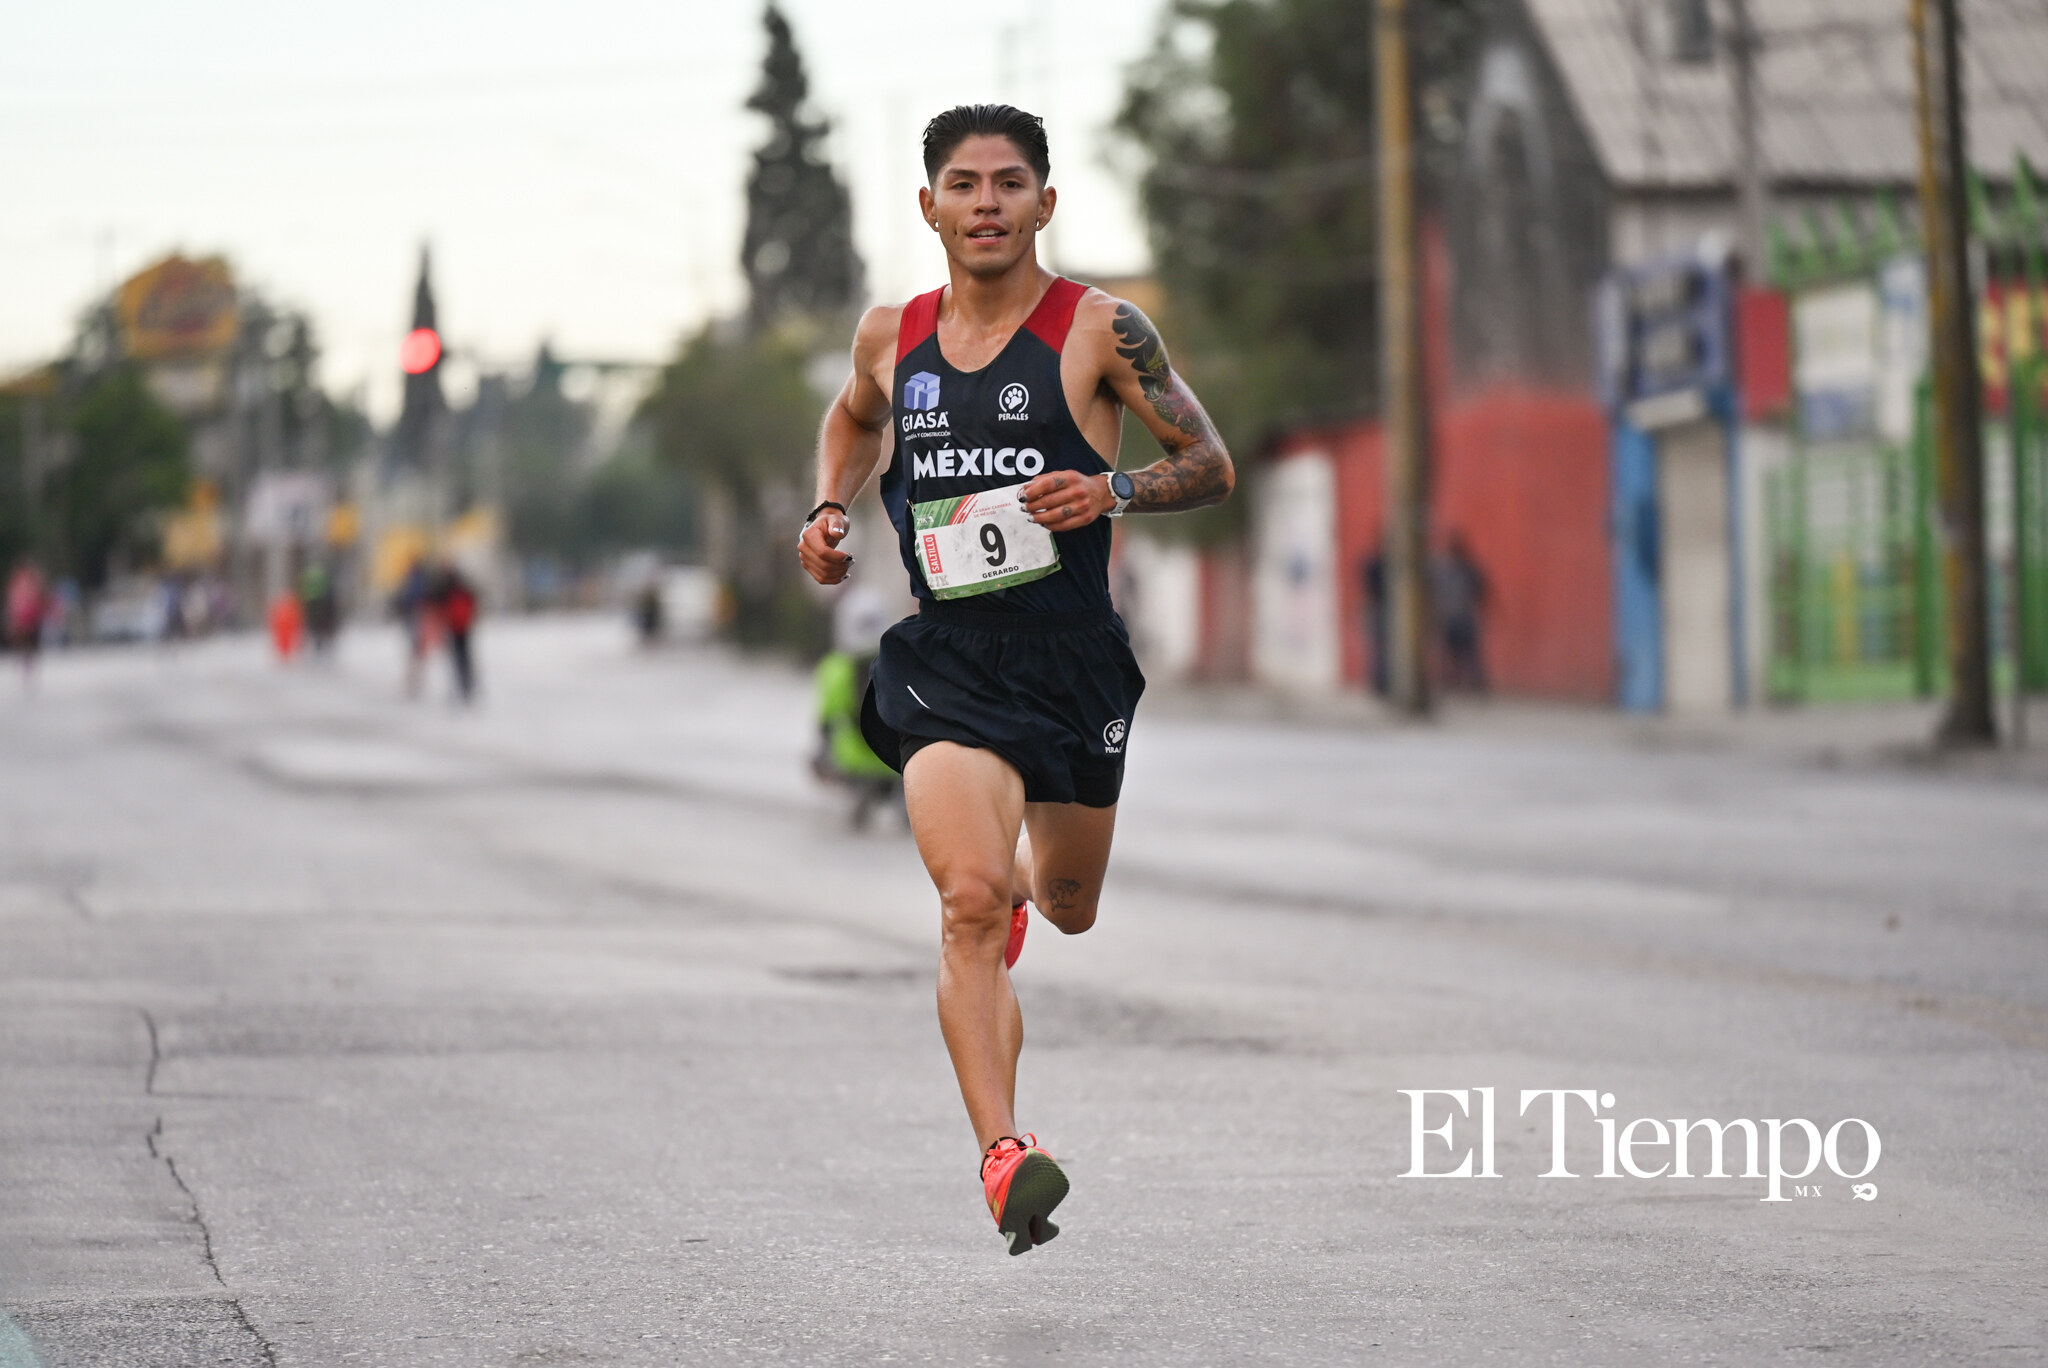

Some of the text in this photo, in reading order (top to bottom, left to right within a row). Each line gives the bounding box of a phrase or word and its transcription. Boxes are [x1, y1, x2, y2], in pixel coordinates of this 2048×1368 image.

[902, 411, 950, 432] GIASA
[998, 413, 1029, 421] PERALES
[913, 443, 1045, 480] MÉXICO
[926, 536, 940, 572] SALTILLO
[979, 523, 1006, 567] 9
[982, 565, 1019, 579] GERARDO
